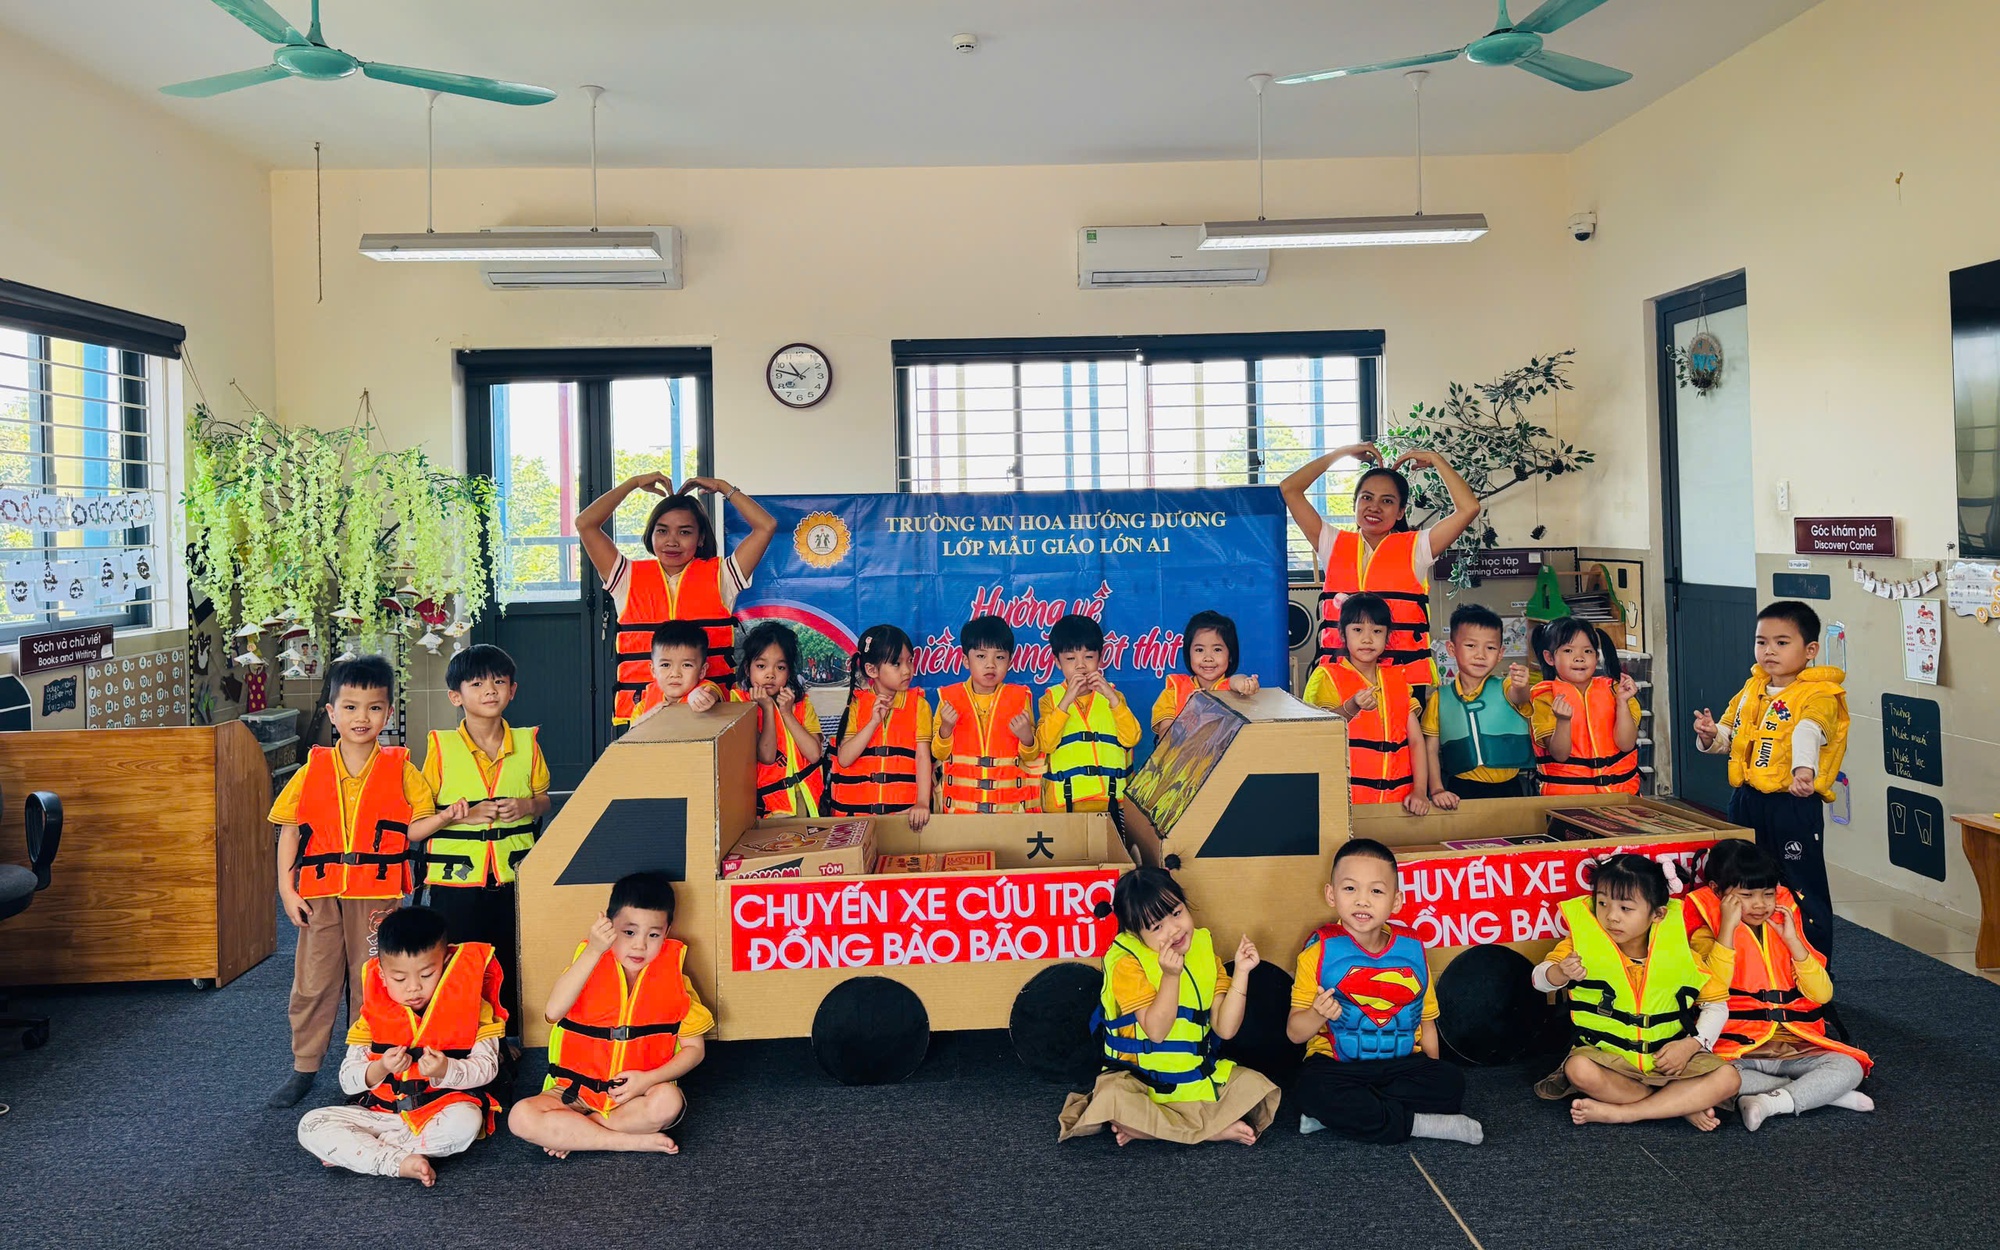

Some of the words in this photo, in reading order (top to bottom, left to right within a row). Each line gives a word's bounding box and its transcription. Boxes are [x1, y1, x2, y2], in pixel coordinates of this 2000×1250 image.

[885, 513, 975, 532] TRƯỜNG
[981, 514, 1014, 532] MN
[1019, 514, 1064, 531] HOA
[1070, 510, 1146, 530] HƯỚNG
[1150, 510, 1226, 529] DƯƠNG
[1811, 524, 1829, 536] Góc
[1831, 524, 1856, 537] khám
[1859, 524, 1877, 539] phá
[942, 537, 984, 556] LỚP
[988, 535, 1035, 556] MẪU
[1042, 534, 1094, 555] GIÁO
[1100, 536, 1142, 554] LỚN
[1147, 536, 1170, 553] A1
[1814, 540, 1848, 551] Discovery
[1849, 540, 1874, 551] Corner
[1502, 556, 1519, 566] tập
[970, 585, 1066, 639] Hướng
[33, 640, 54, 654] Sách
[56, 638, 68, 650] và
[69, 634, 86, 648] chữ
[86, 632, 102, 645] viết
[1132, 626, 1184, 679] thịt
[38, 655, 59, 666] Books
[60, 652, 74, 662] and
[75, 650, 96, 659] Writing
[1755, 742, 1772, 768] Swim
[1026, 831, 1054, 859] 大
[821, 864, 842, 874] TÔM
[1398, 856, 1514, 904] HUYẾN
[1522, 860, 1566, 896] XE
[734, 881, 888, 929] CHUYẾN
[898, 888, 946, 923] XE
[956, 876, 1036, 921] CỨU
[748, 926, 874, 971] ĐỒNG
[884, 923, 960, 965] BÀO
[970, 922, 1048, 962] BÃO
[1058, 916, 1096, 958] LŨ
